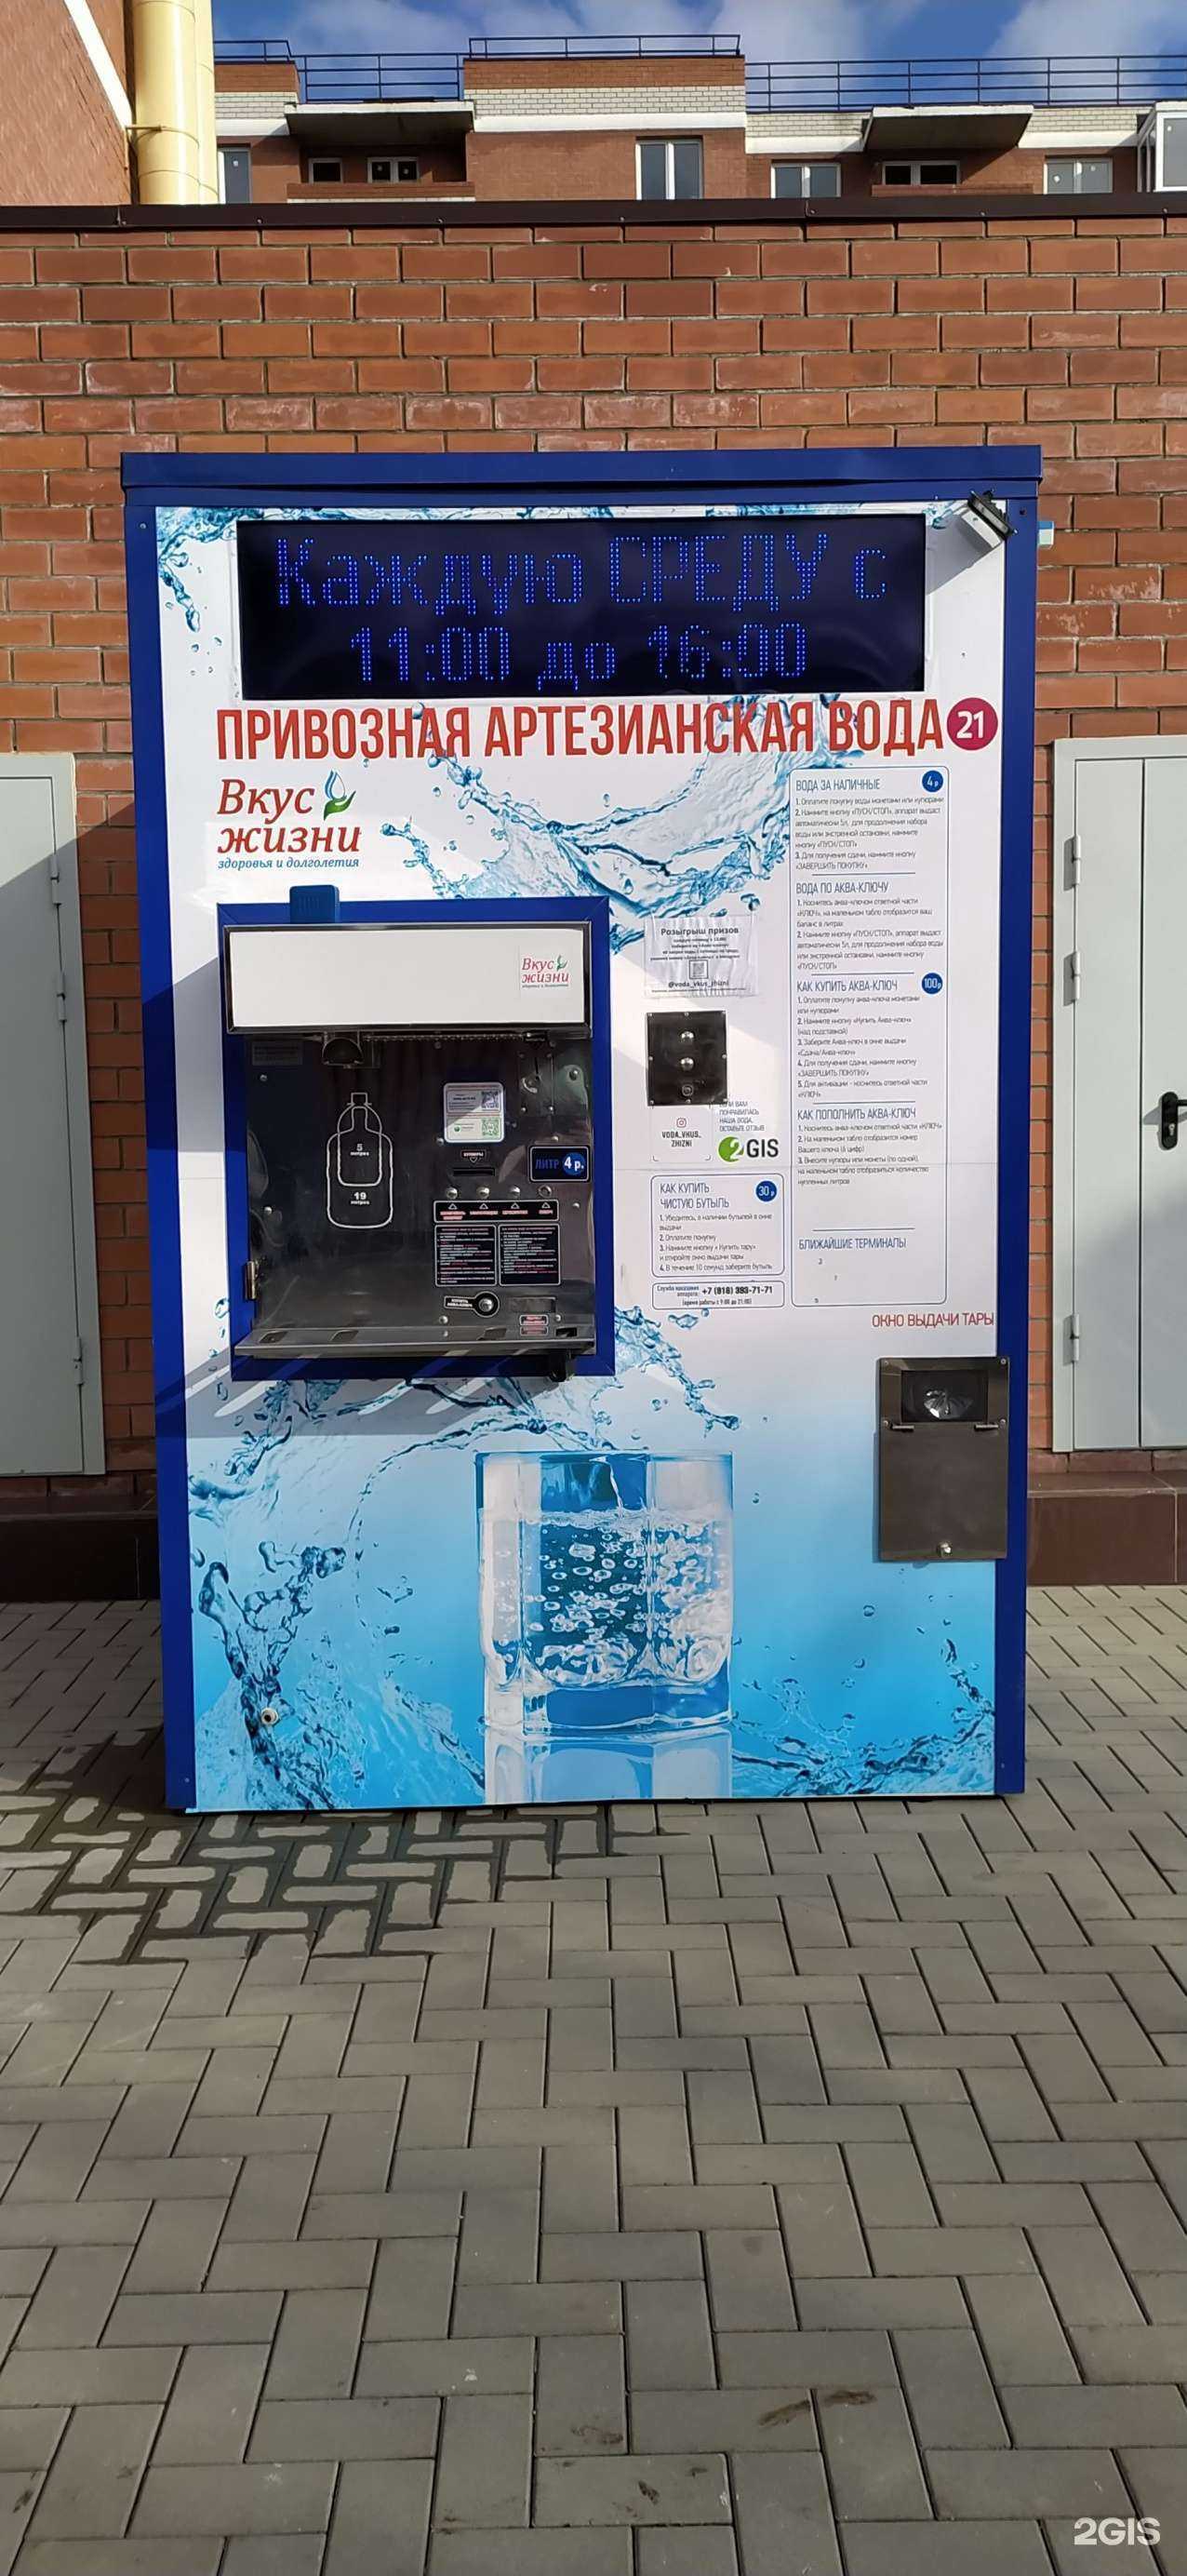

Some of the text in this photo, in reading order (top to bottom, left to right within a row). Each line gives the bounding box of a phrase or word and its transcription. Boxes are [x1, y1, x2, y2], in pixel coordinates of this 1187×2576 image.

[277, 533, 887, 616] Каждую СРЕДУ с
[350, 622, 808, 691] 11:00 до 16:00
[216, 698, 944, 760] ПРИВОЗНАЯ АРТЕЗИАНСКАЯ ВОДА
[956, 710, 988, 739] 21
[795, 779, 880, 793] ВОДА ЗА НАЛИЧНЫЕ
[217, 778, 315, 825] Вкус
[217, 826, 362, 854] жизни
[218, 856, 359, 871] здоровья и долголетия
[795, 881, 888, 895] ВОДА ПО АКВА-КЛЮЧУ
[660, 928, 740, 936] Розыгрыш призов
[521, 957, 554, 973] Вкус
[521, 973, 569, 984] жизни
[796, 980, 898, 991] КАК КУПИТЬ АКВА-КЛЮЧ
[797, 1107, 916, 1120] КАК ПОПОЛНИТЬ АКВА-КЛЮЧ
[356, 1143, 363, 1151] 5
[535, 1159, 559, 1170] ЛИТР
[563, 1156, 572, 1169] 4
[660, 1182, 710, 1193] КАК КУПИТЬ
[353, 1191, 367, 1200] 19
[660, 1198, 729, 1209] ЧИСТУЮ БУТЫЛЬ
[798, 1236, 907, 1250] БЛИЖАЙШИЕ ТЕРМИНАЛЫ
[872, 1312, 994, 1329] ОКНО ВЫДАЧИ ТАРЫ
